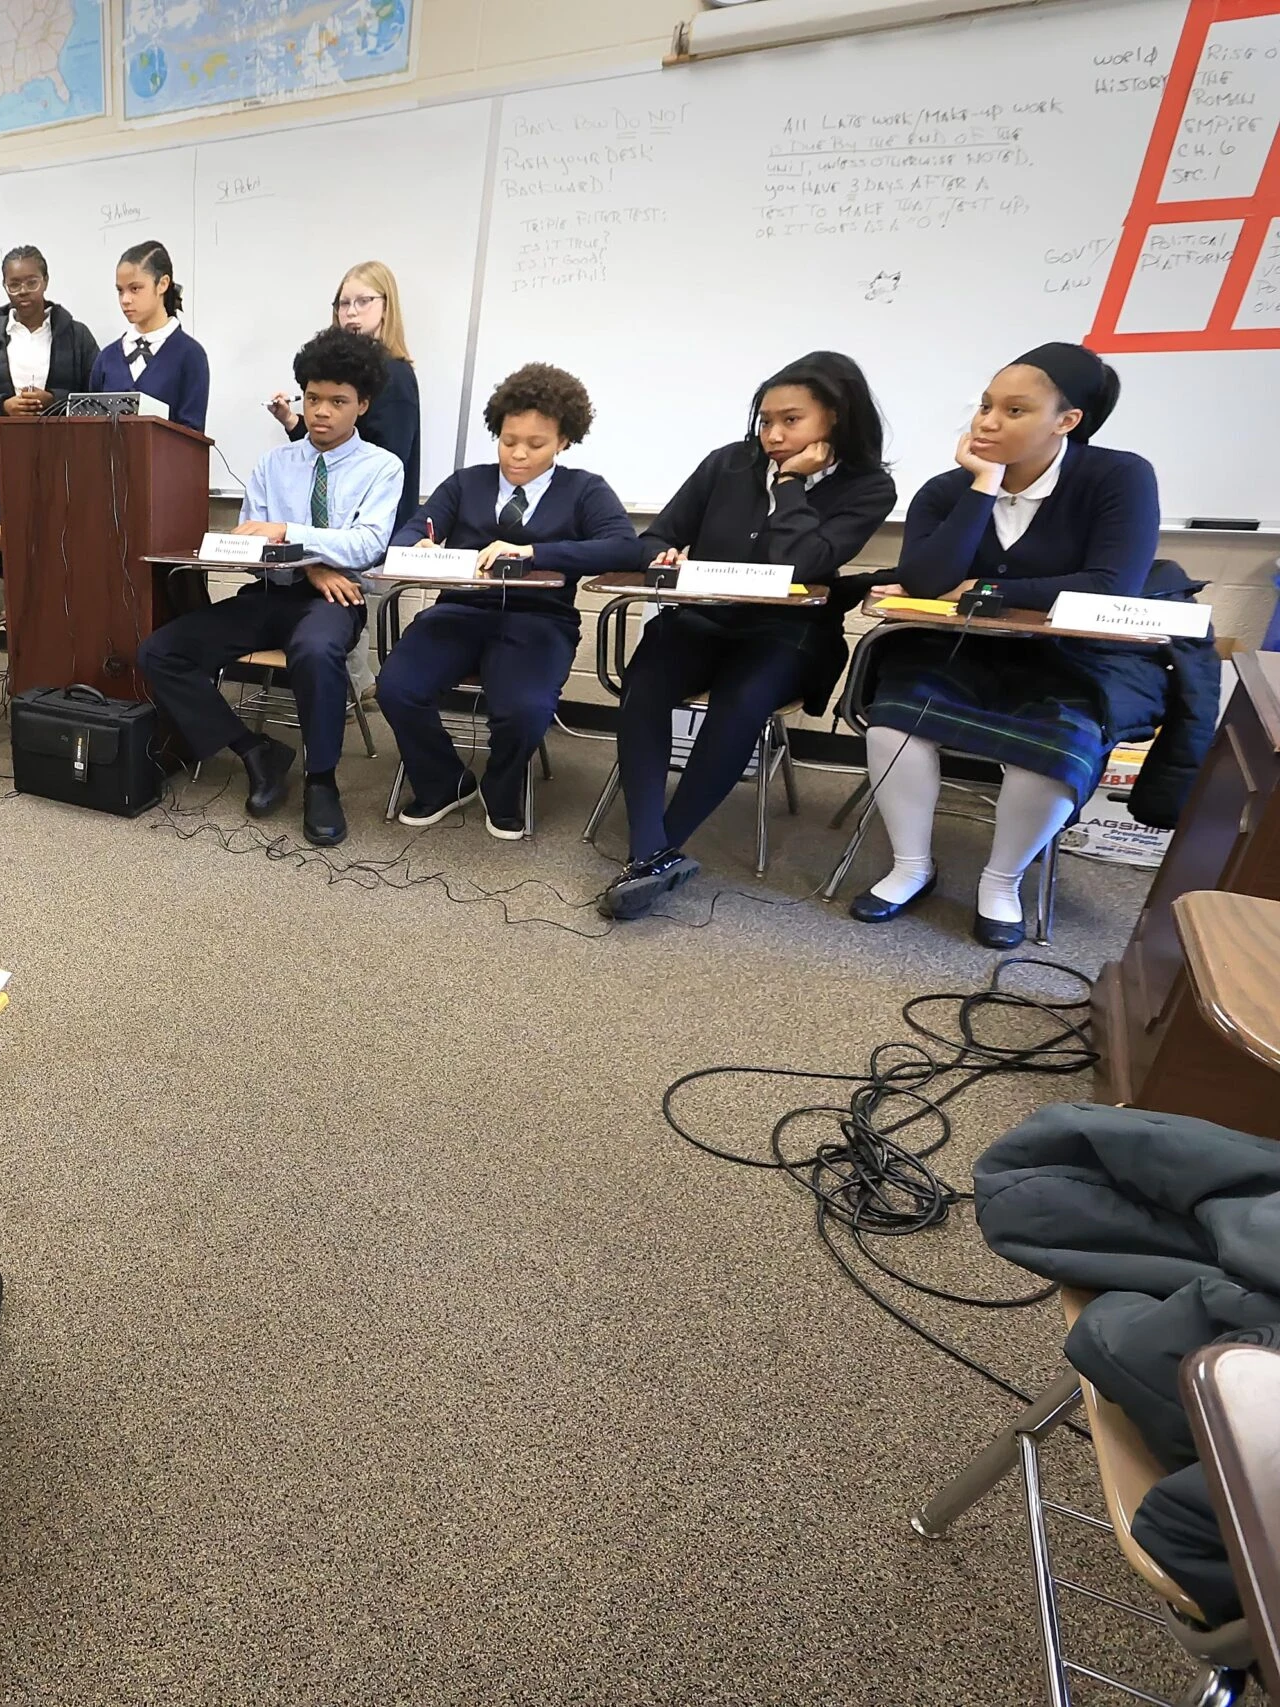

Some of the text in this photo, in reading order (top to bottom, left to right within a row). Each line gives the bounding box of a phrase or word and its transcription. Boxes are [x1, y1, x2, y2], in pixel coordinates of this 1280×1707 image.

[1219, 139, 1236, 155] 6
[1102, 833, 1163, 847] Copy Paper
